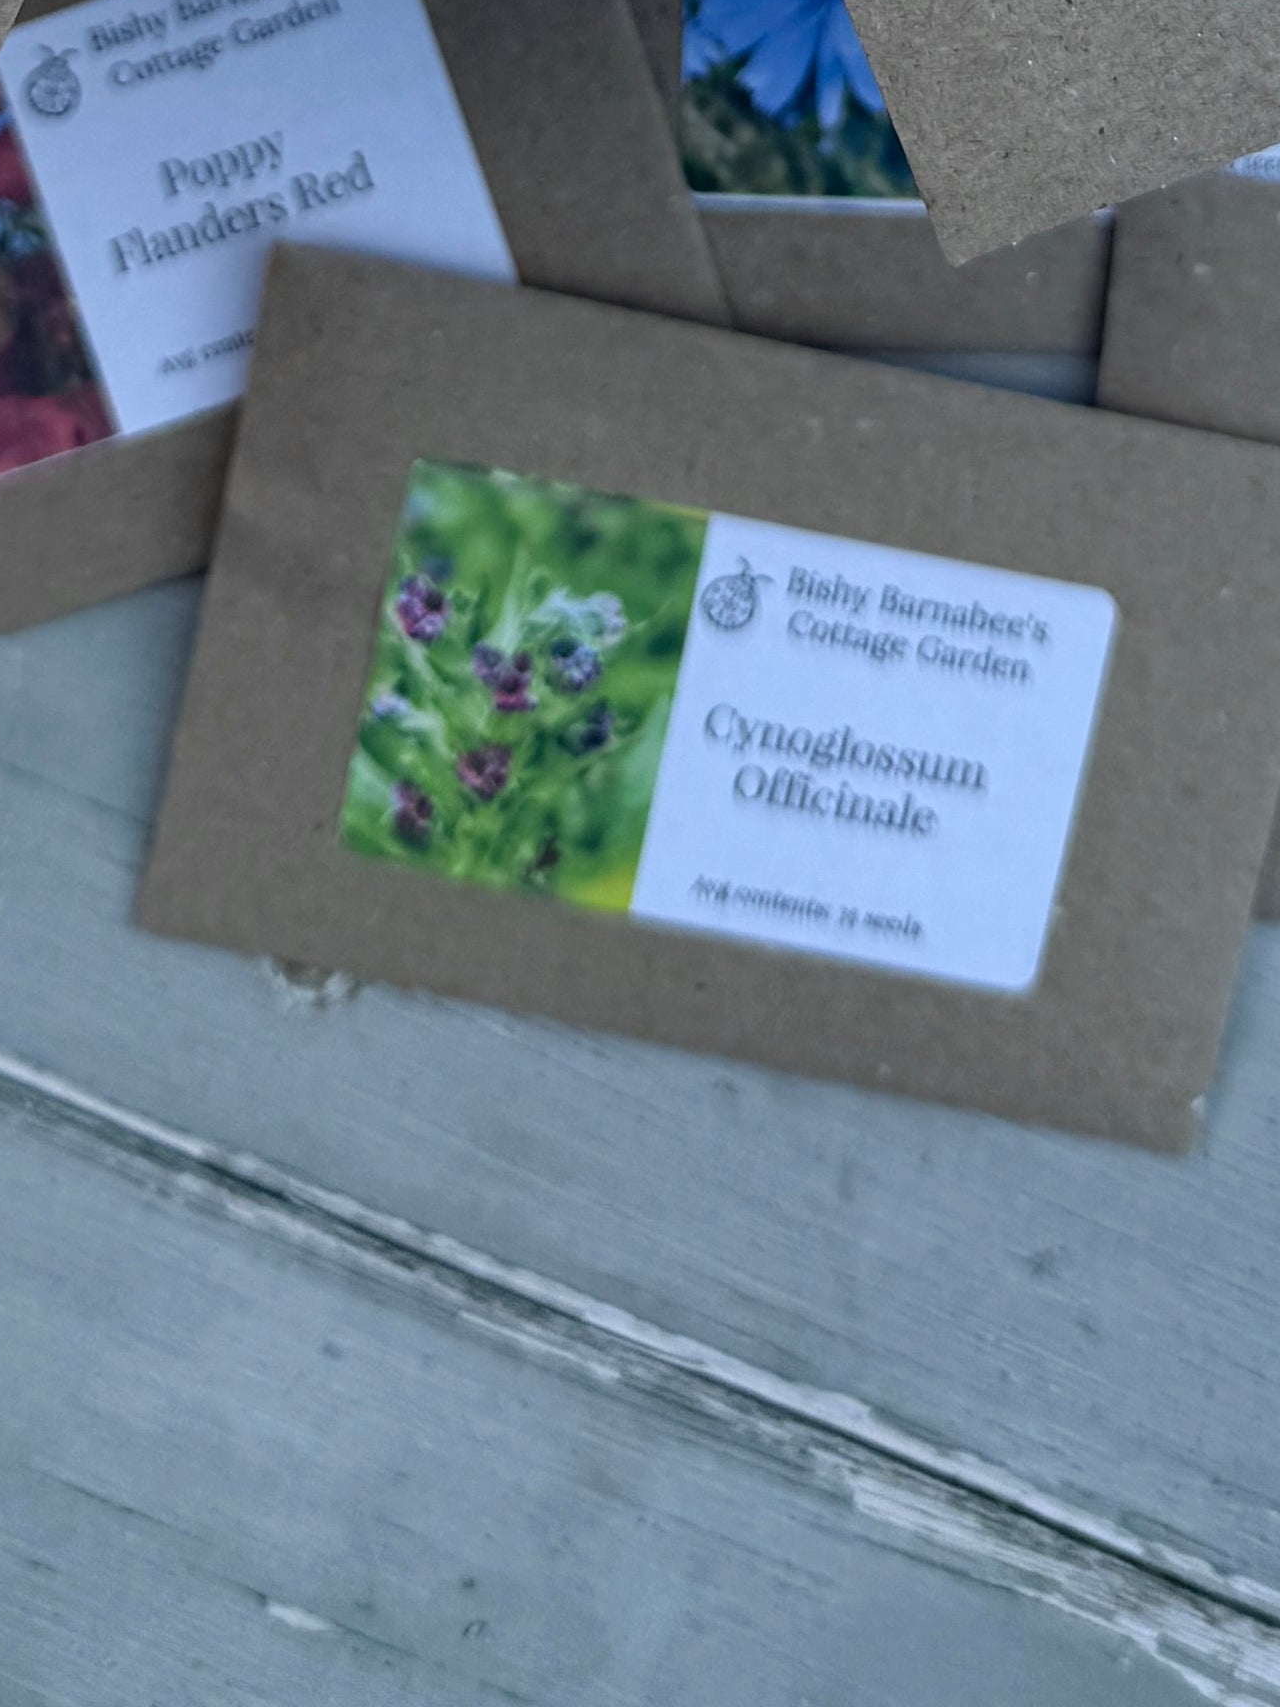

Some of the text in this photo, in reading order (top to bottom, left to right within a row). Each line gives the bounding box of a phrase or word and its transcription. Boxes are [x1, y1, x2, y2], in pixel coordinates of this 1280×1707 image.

[88, 9, 168, 53] Bishy
[108, 34, 222, 87] Cottage
[159, 131, 285, 197] Poppy
[107, 151, 375, 274] Flanders Red
[787, 567, 1049, 645] Bishy Barnabee's
[788, 610, 1031, 686] Cottage Garden
[704, 704, 988, 795] Cynoglossum
[734, 765, 937, 837] Officinale
